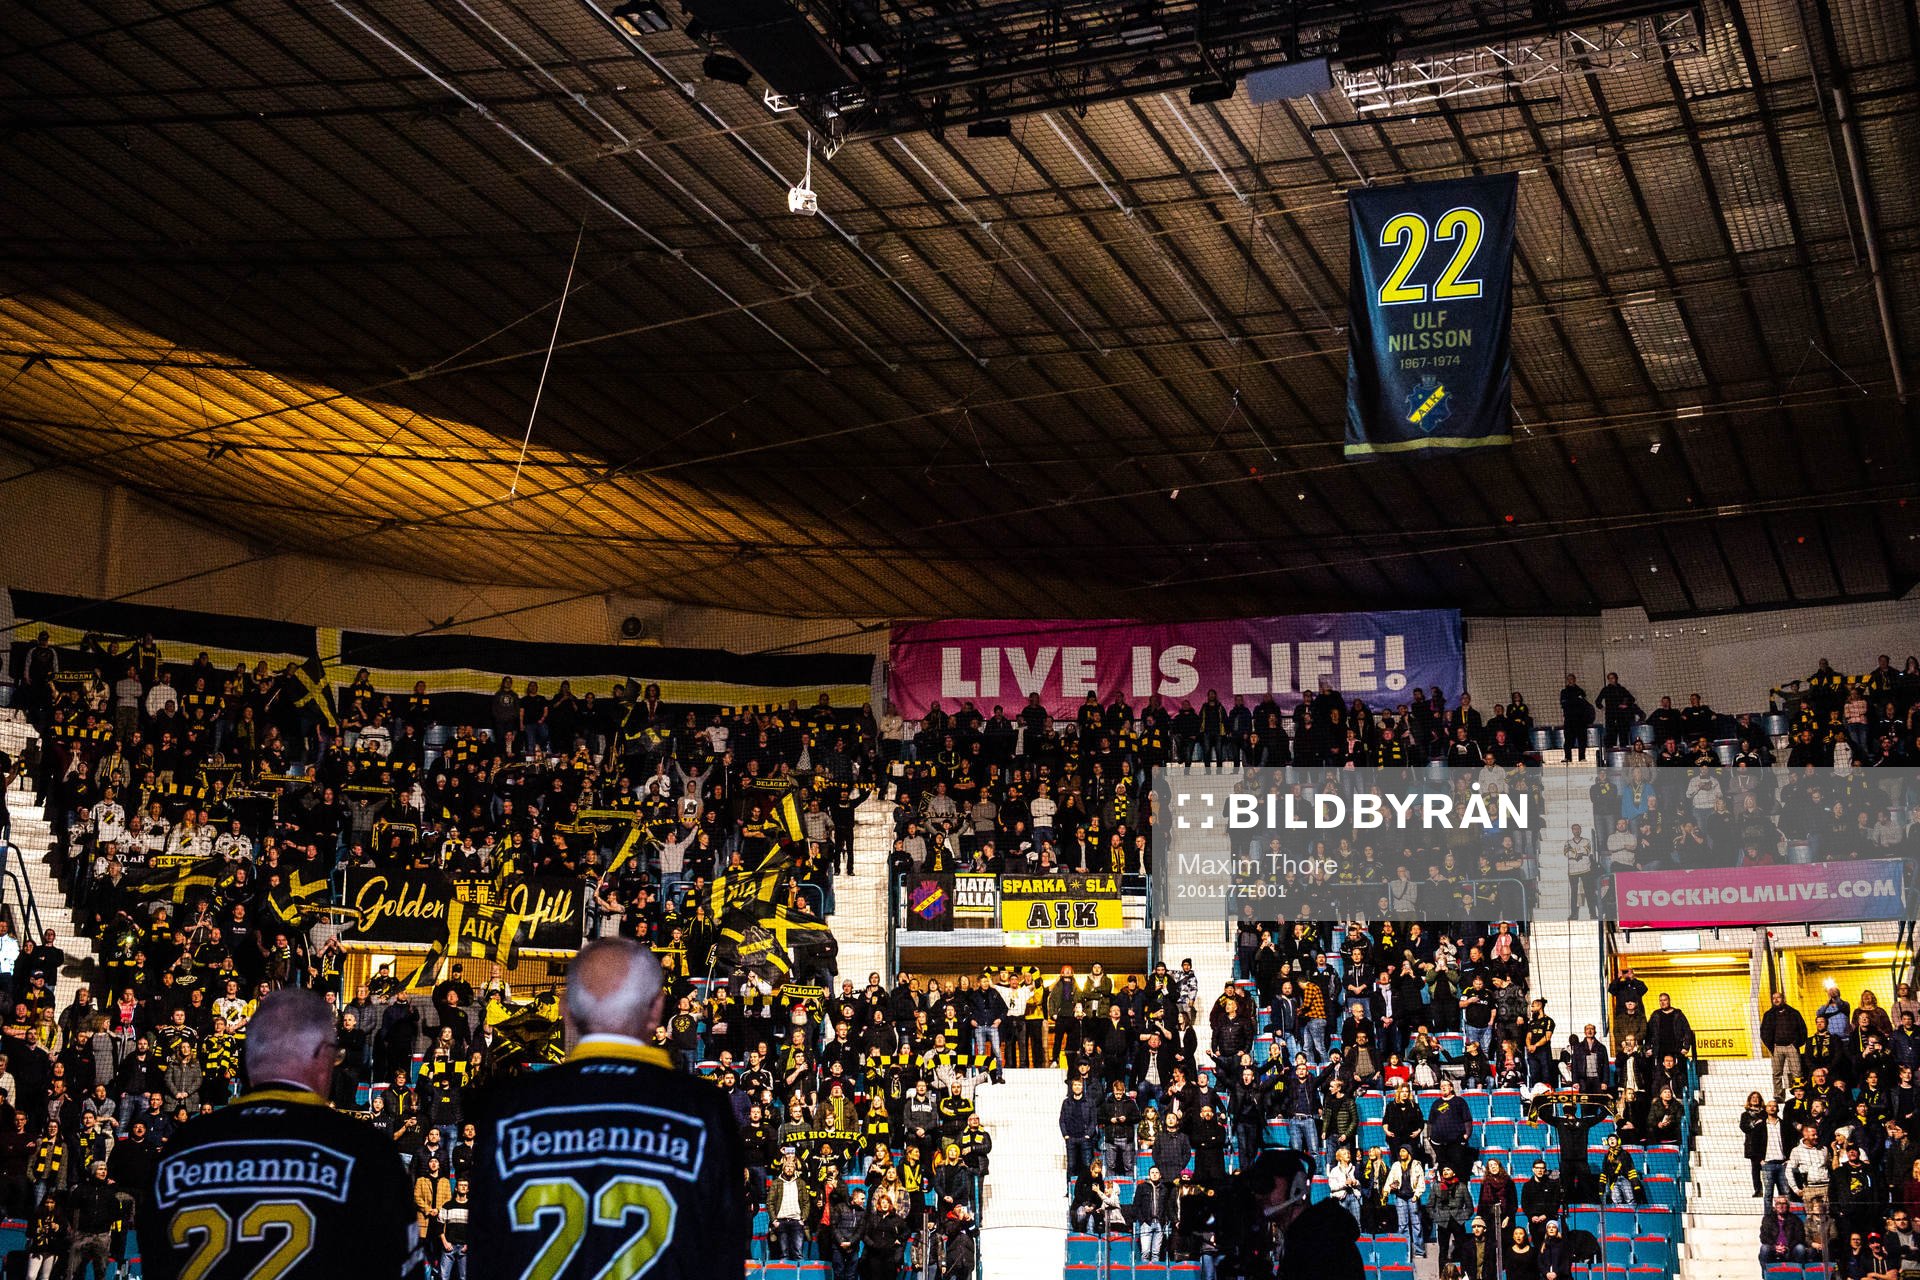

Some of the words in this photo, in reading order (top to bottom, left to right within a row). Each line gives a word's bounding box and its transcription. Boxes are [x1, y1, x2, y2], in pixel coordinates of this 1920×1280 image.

[1378, 207, 1484, 306] 22
[1413, 311, 1448, 331] ULF
[1388, 330, 1472, 353] NILSSON
[1400, 355, 1461, 370] 1967-1974
[942, 646, 1098, 698] LIVE
[1132, 645, 1199, 697] IS
[1231, 634, 1407, 695] LIFE!
[956, 878, 995, 891] HATA
[1002, 879, 1066, 893] SPARKA
[1085, 876, 1117, 893] SLÅ
[1626, 879, 1896, 907] STOCKHOLMLIVE.COM
[356, 876, 445, 933] Golden
[510, 884, 575, 940] Hill
[956, 892, 994, 906] ALLA
[1027, 902, 1098, 929] AIK
[462, 917, 499, 945] AIK
[1696, 1039, 1734, 1048] URGERS
[508, 1123, 690, 1163] Bemannia
[786, 1132, 806, 1142] AIK
[809, 1131, 861, 1141] HOCKEY
[168, 1200, 316, 1280] 22
[508, 1175, 678, 1280] 22
